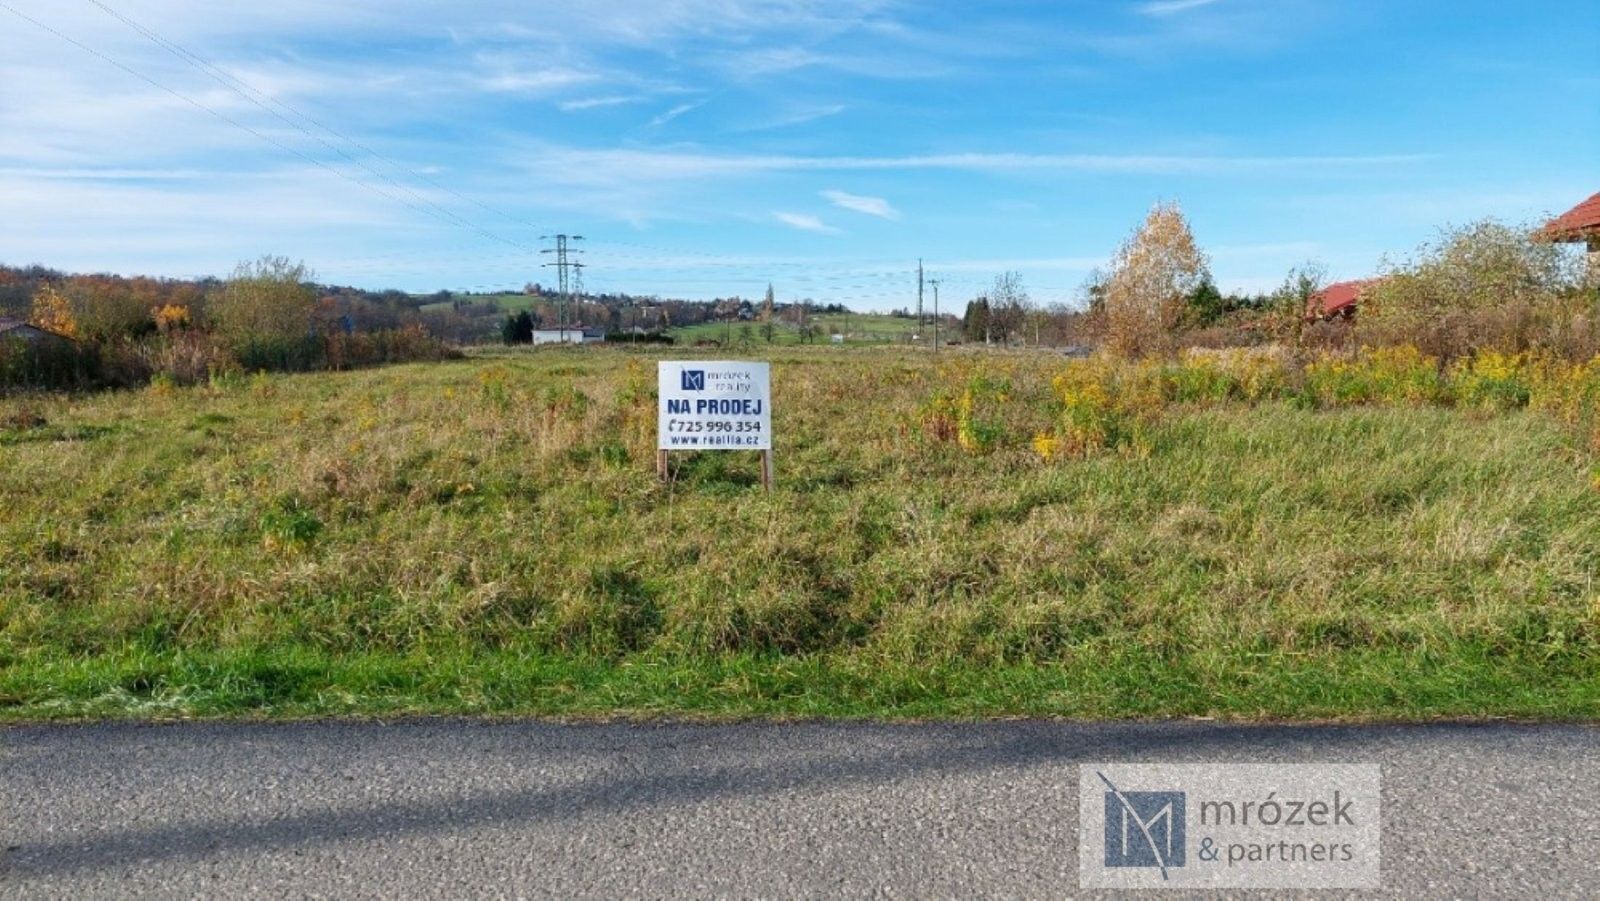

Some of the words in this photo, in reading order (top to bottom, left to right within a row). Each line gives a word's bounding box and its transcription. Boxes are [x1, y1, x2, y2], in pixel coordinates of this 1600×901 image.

[667, 399, 691, 415] NA
[696, 399, 762, 415] PRODEJ
[677, 421, 703, 432] 725
[706, 421, 732, 432] 996
[735, 421, 761, 432] 354
